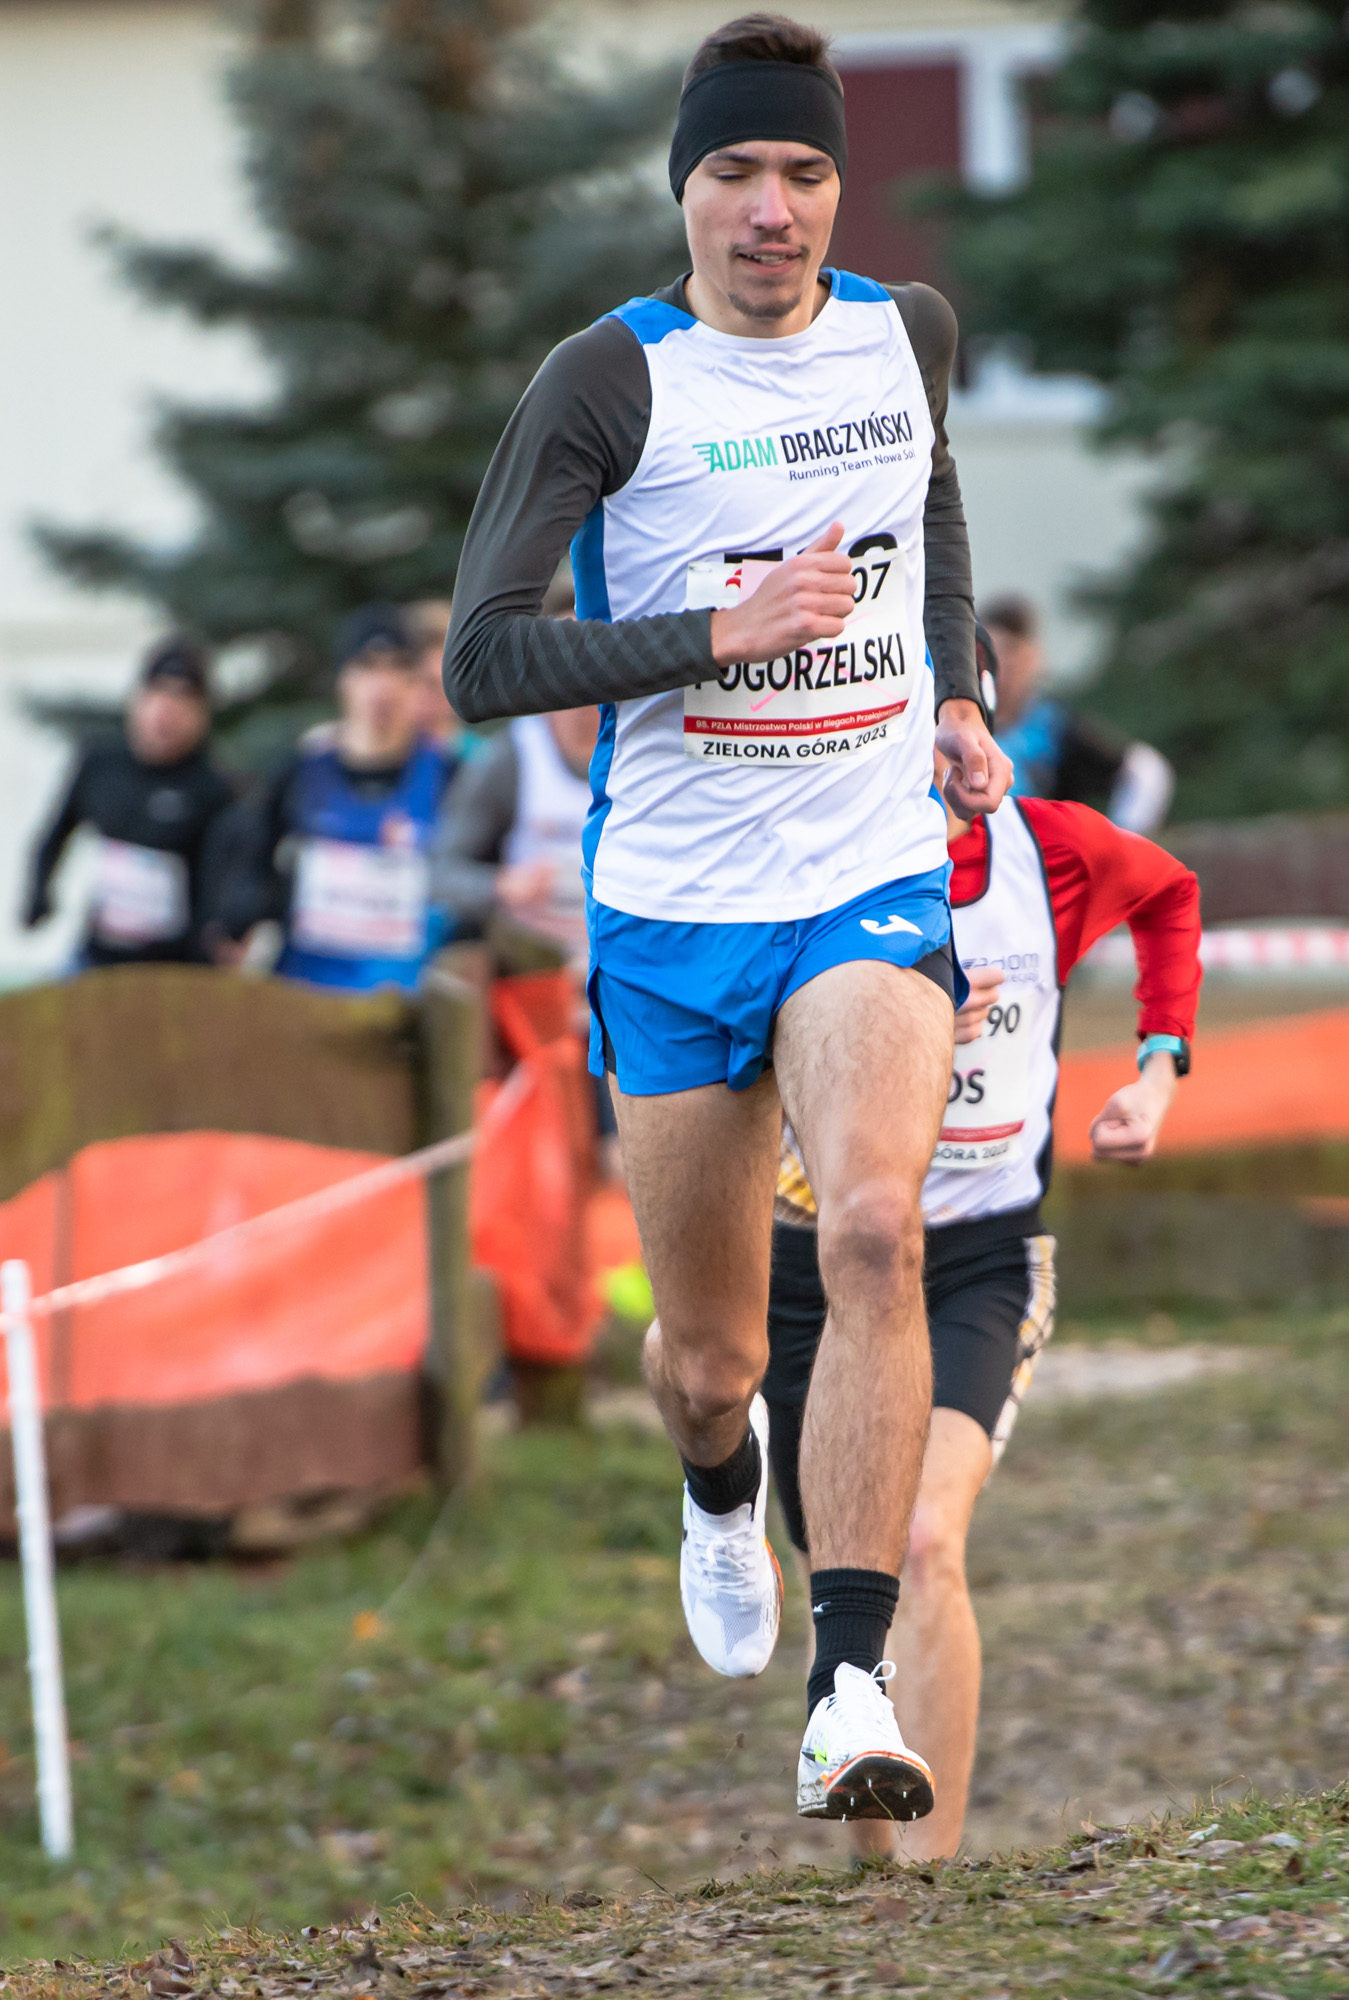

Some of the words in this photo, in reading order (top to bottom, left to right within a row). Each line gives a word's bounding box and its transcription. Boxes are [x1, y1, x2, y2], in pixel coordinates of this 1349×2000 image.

[704, 436, 779, 473] ADAM
[780, 411, 914, 464] DRACZYŃSKI
[789, 464, 840, 481] Running
[842, 459, 873, 472] Team
[874, 453, 902, 465] Nowa
[695, 632, 906, 692] OGORZELSKI
[703, 741, 791, 759] ZIELONA
[796, 737, 850, 758] GÓRA
[854, 723, 887, 749] 2023
[711, 721, 732, 731] PZLA
[733, 722, 787, 732] Mistrzostwa
[788, 722, 814, 731] Polski
[814, 722, 822, 730] w
[822, 715, 855, 730] Biegach
[986, 1002, 1021, 1037] 90
